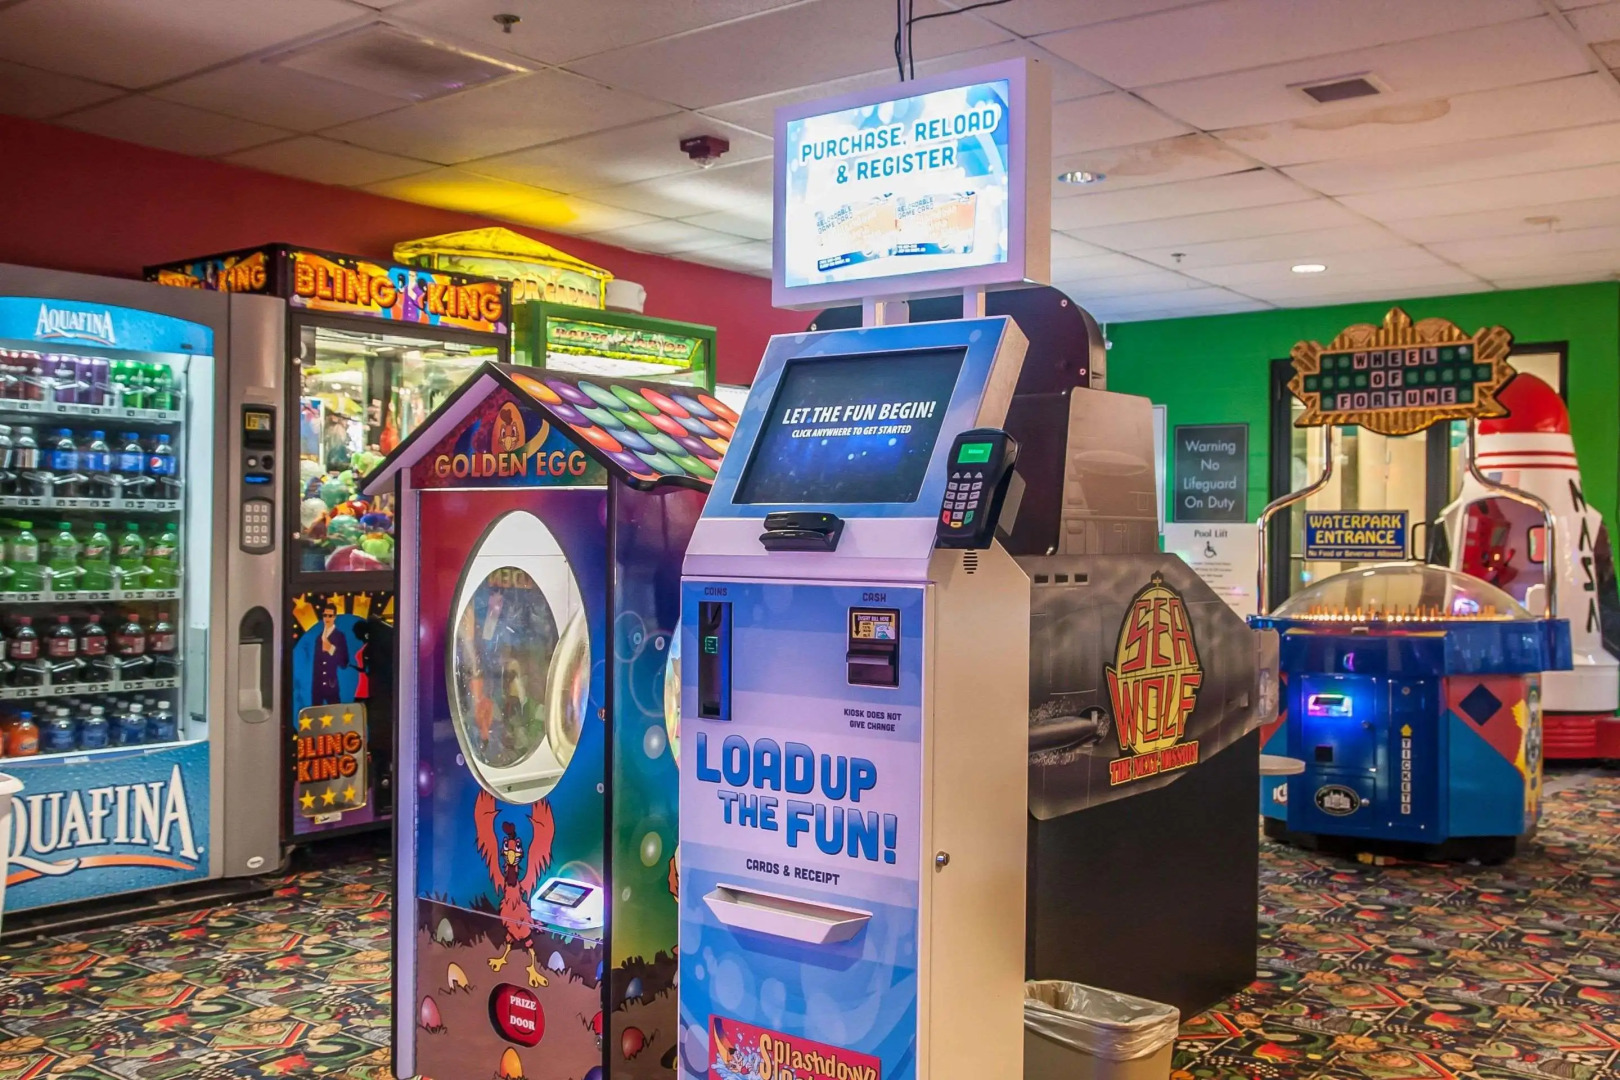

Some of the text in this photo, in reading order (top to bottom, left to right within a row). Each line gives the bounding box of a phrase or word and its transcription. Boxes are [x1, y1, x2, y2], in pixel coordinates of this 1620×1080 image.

[915, 109, 995, 142] RELOAD
[836, 147, 955, 184] & REGISTER
[218, 265, 266, 292] KING
[294, 262, 503, 322] BLING KING
[35, 303, 116, 344] AQUAFINA
[1355, 350, 1436, 367] WHEEL
[1374, 372, 1400, 385] OF
[1340, 389, 1454, 408] FORTUNE
[782, 401, 937, 424] LET THE FUN BEGIN!
[791, 424, 912, 438] CLICK ANYWHERE TO GET STARTED
[1185, 440, 1236, 455] Warning
[435, 450, 587, 478] GOLDEN EGG
[1201, 459, 1220, 470] No
[1183, 477, 1237, 492] Lifeguard
[1184, 496, 1235, 511] On Duty
[1309, 515, 1402, 529] WATERPARK
[1194, 529, 1228, 538] Pool Lift
[1315, 530, 1396, 544] ENTRANCE
[704, 587, 728, 596] COINS
[862, 593, 886, 602] CASH
[1121, 598, 1197, 673] SEA
[843, 709, 902, 721] KIOSK DOES NOT
[1107, 672, 1202, 749] WOLF
[849, 720, 896, 732] GIVE CHANGE
[297, 754, 357, 783] KING
[696, 732, 877, 802] LOAD UP
[1110, 741, 1199, 785] THE NEXT MISSION
[1402, 739, 1411, 814] TICKETS
[8, 764, 200, 875] QUAFINA
[717, 790, 898, 864] THE FUN!
[746, 859, 840, 886] CARDS & RECEIPT
[509, 995, 537, 1011] PRIZE
[509, 1015, 536, 1031] DOOR
[759, 1033, 877, 1080] Splashdown
